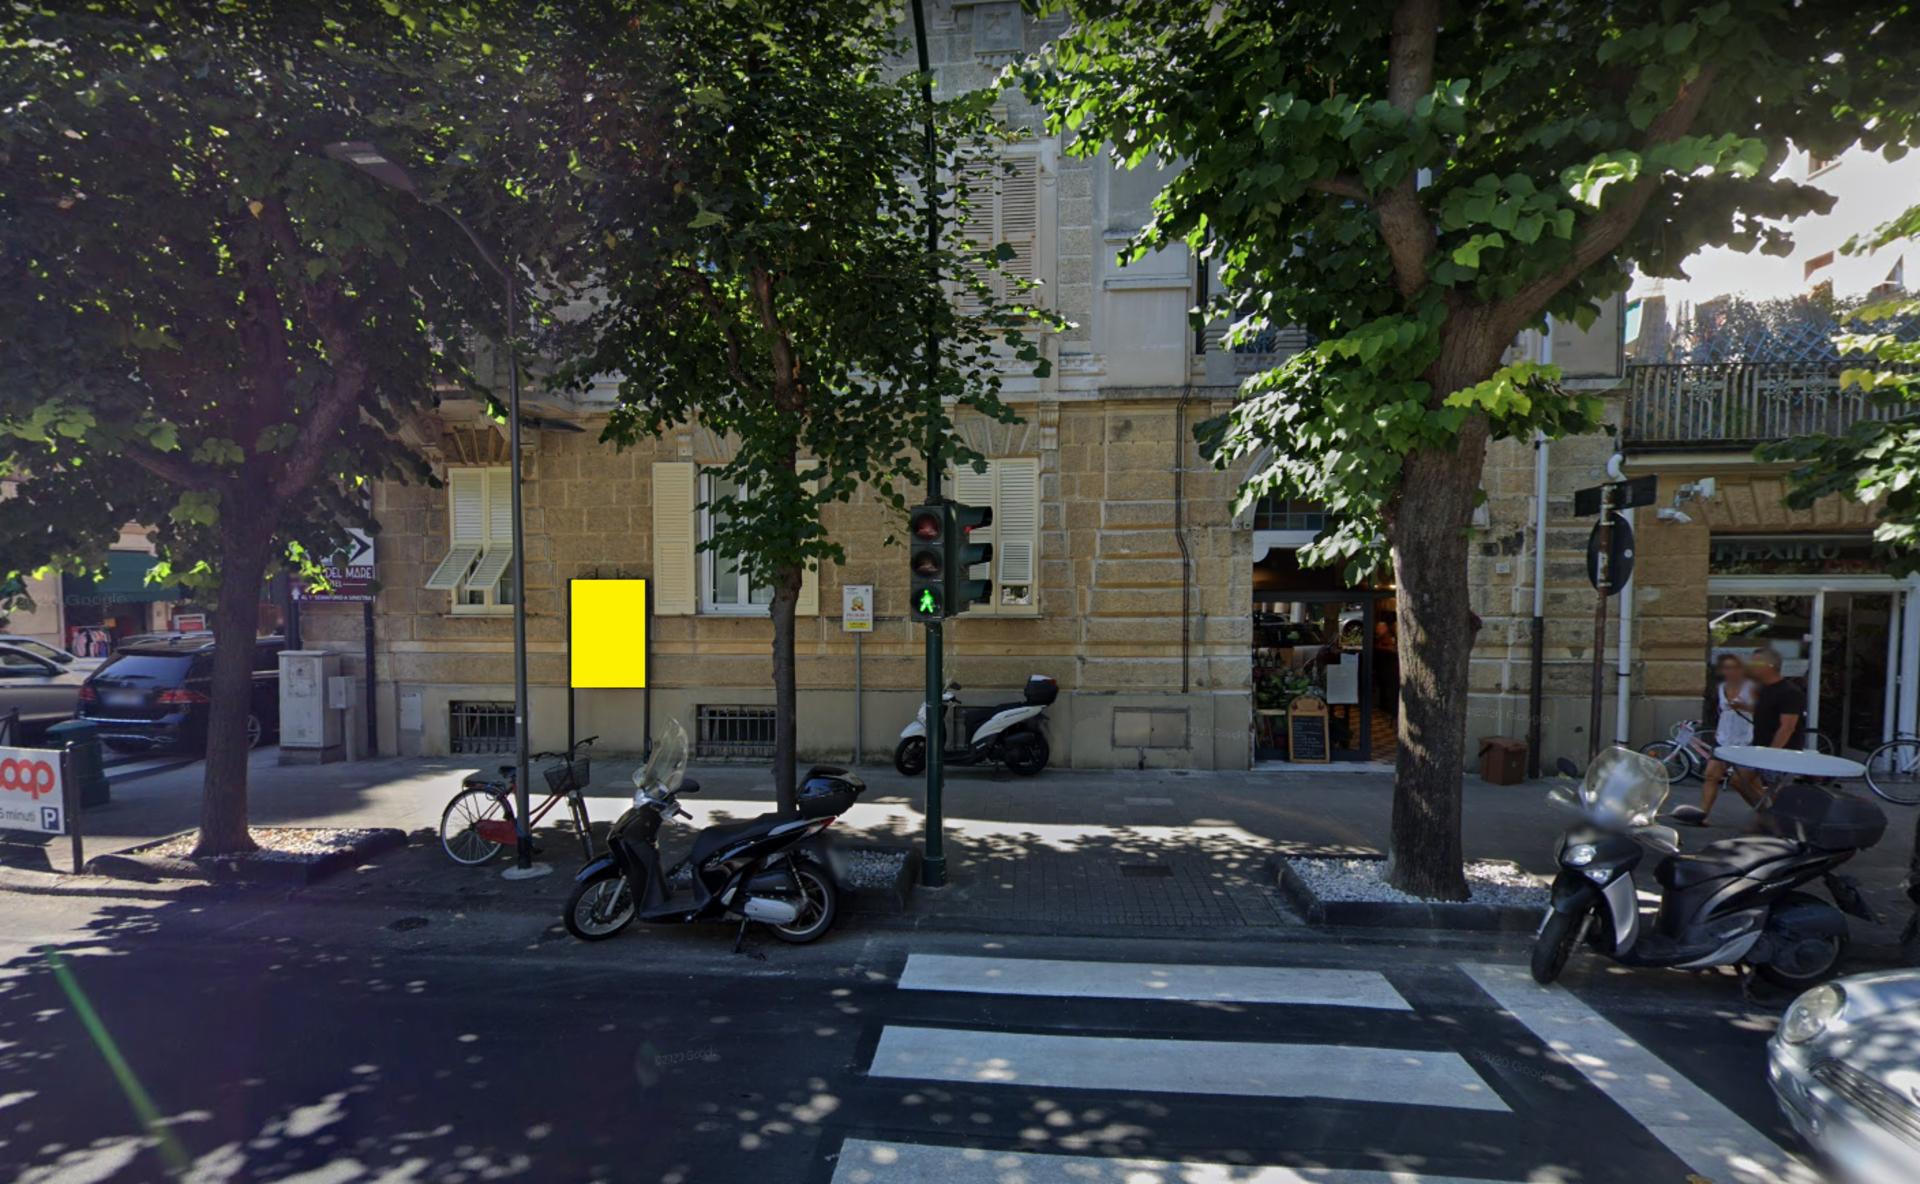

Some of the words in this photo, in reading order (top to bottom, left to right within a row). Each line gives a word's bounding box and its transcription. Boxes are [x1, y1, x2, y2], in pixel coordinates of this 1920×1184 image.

[345, 566, 373, 578] MARE
[0, 757, 56, 800] oop
[44, 808, 57, 829] P
